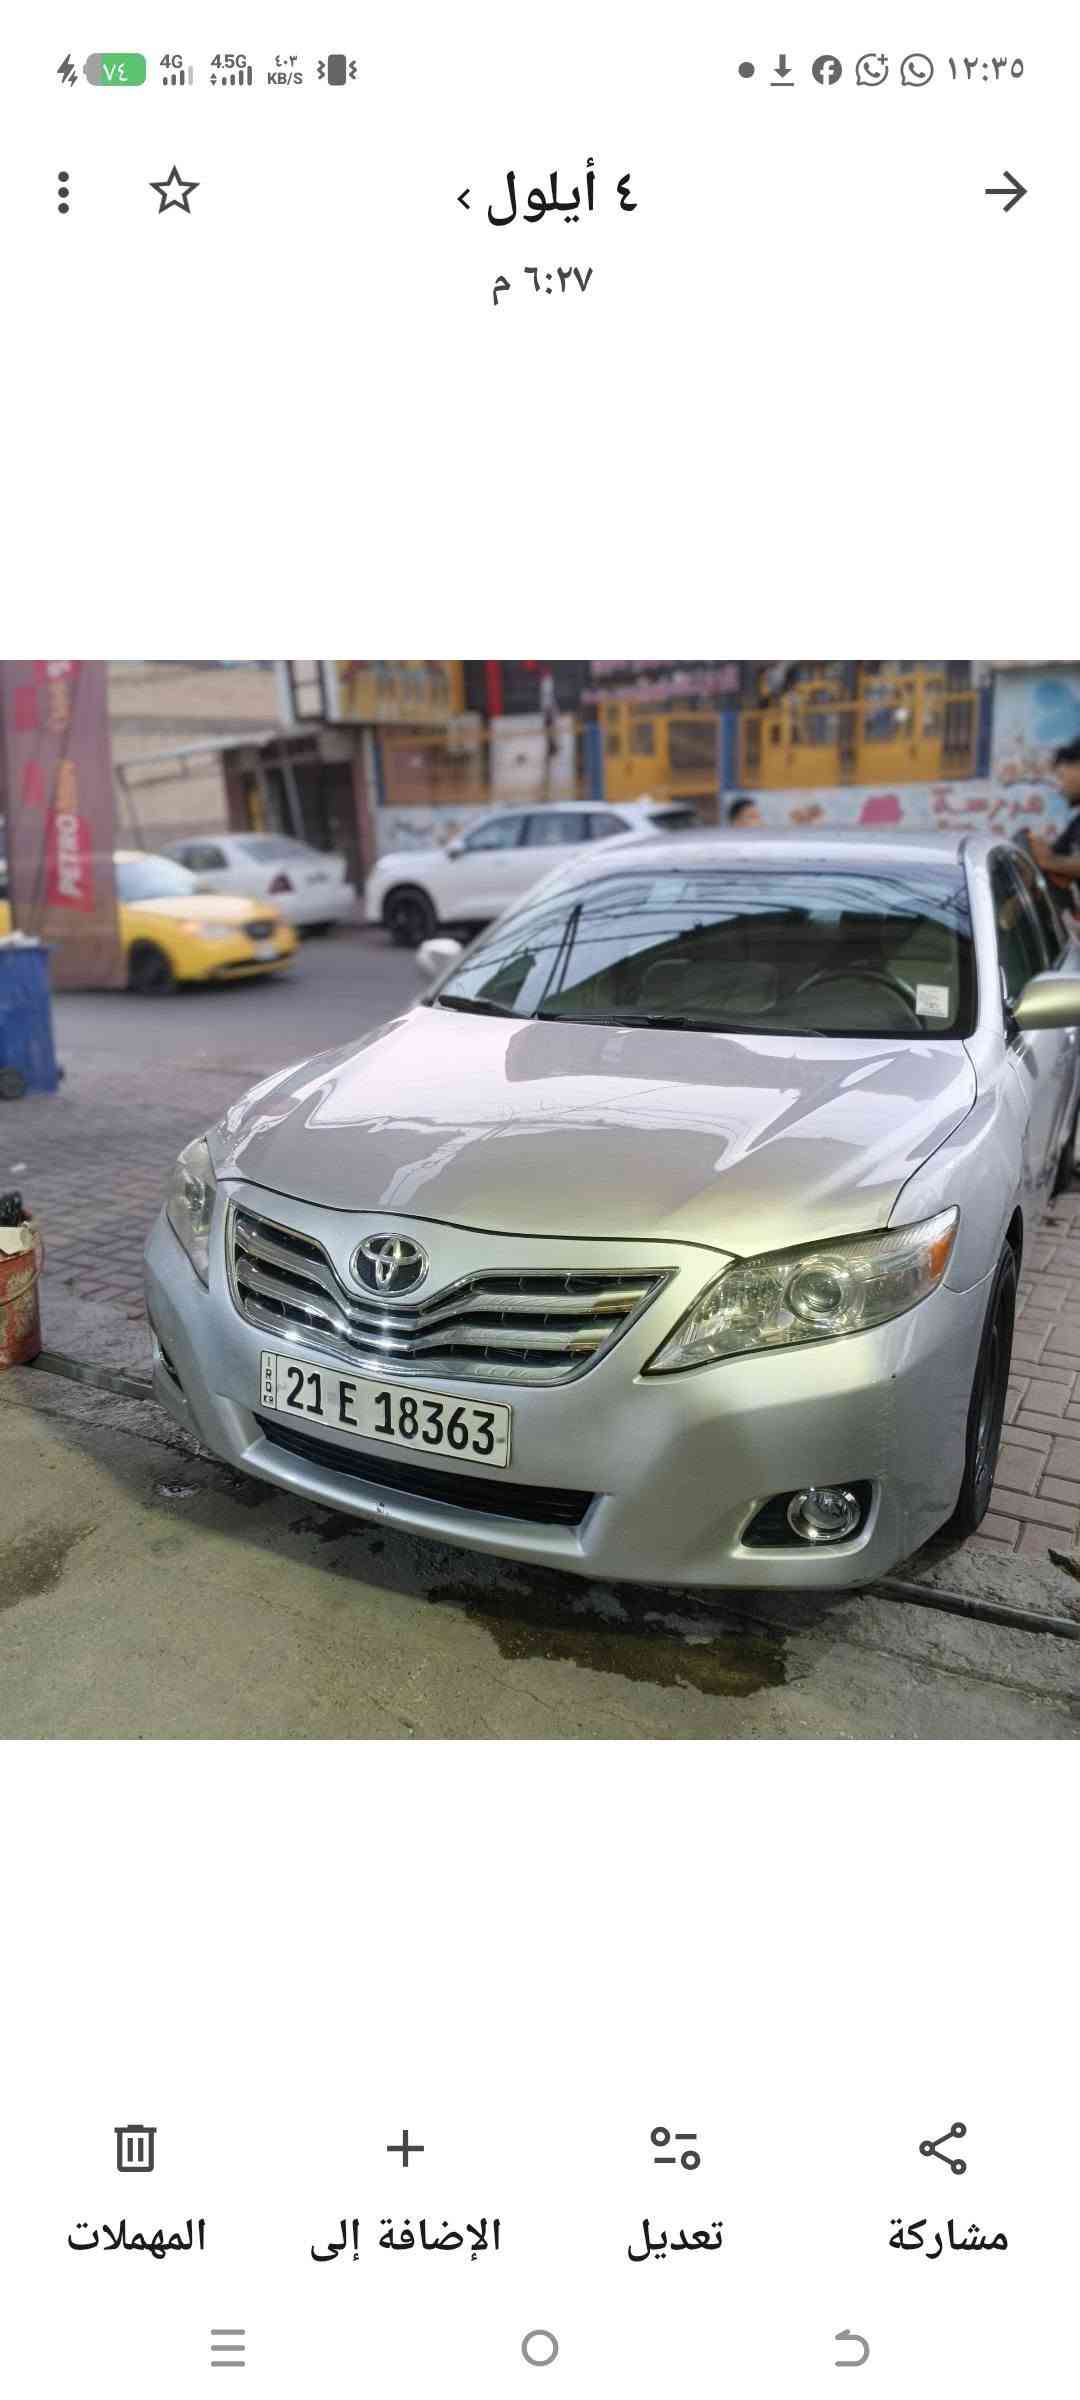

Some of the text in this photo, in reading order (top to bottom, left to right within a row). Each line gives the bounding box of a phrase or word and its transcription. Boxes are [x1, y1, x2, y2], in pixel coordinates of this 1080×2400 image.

[287, 1366, 495, 1455] 21 E 18363
